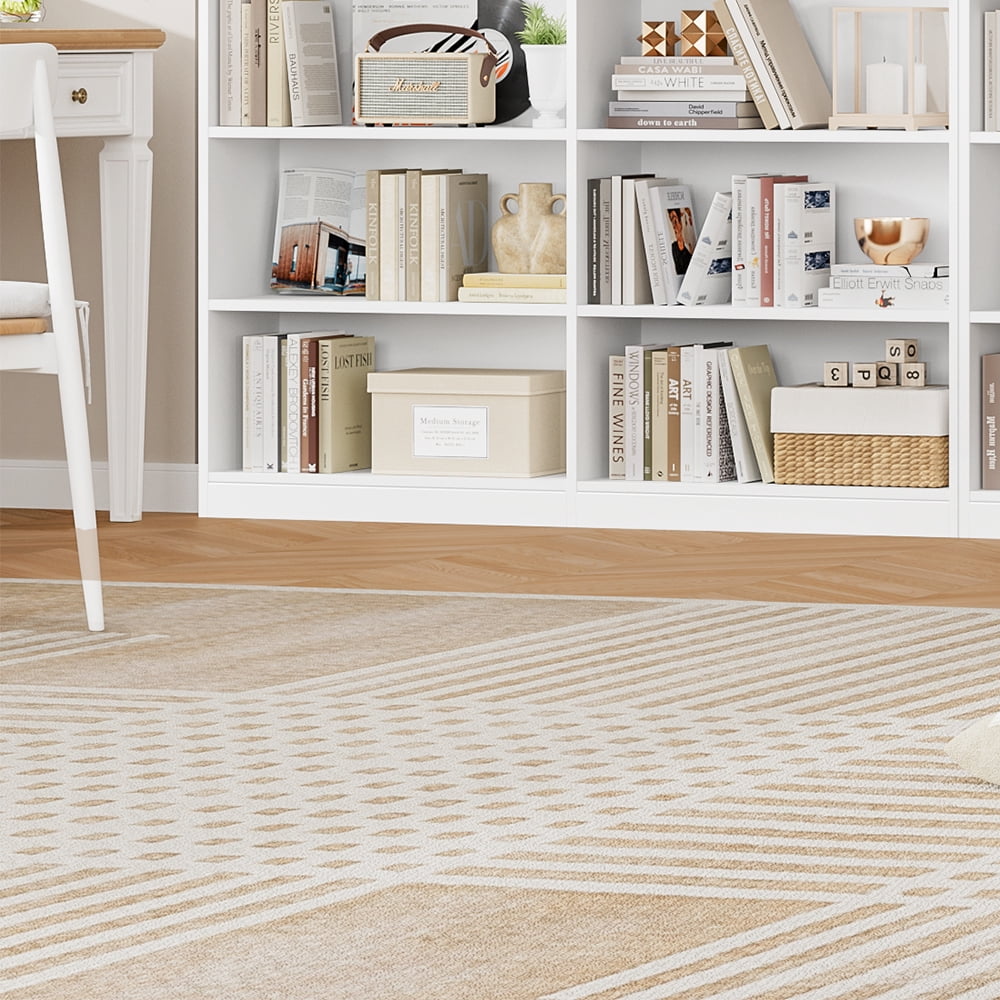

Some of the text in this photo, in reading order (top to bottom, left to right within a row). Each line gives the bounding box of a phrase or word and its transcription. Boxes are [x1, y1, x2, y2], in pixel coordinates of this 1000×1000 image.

[288, 53, 300, 101] BAUHAUS
[664, 77, 704, 88] WHITE
[368, 203, 377, 265] KINFOLK
[409, 203, 418, 265] KINFOLK
[832, 278, 863, 290] Elliott
[867, 278, 901, 290] Erwitt
[334, 352, 372, 369] LOST FISH
[321, 344, 330, 402] LOST FISH
[669, 379, 678, 400] ART
[682, 379, 692, 400] ART
[453, 419, 480, 427] Storage
[613, 373, 624, 463] FINE WINES
